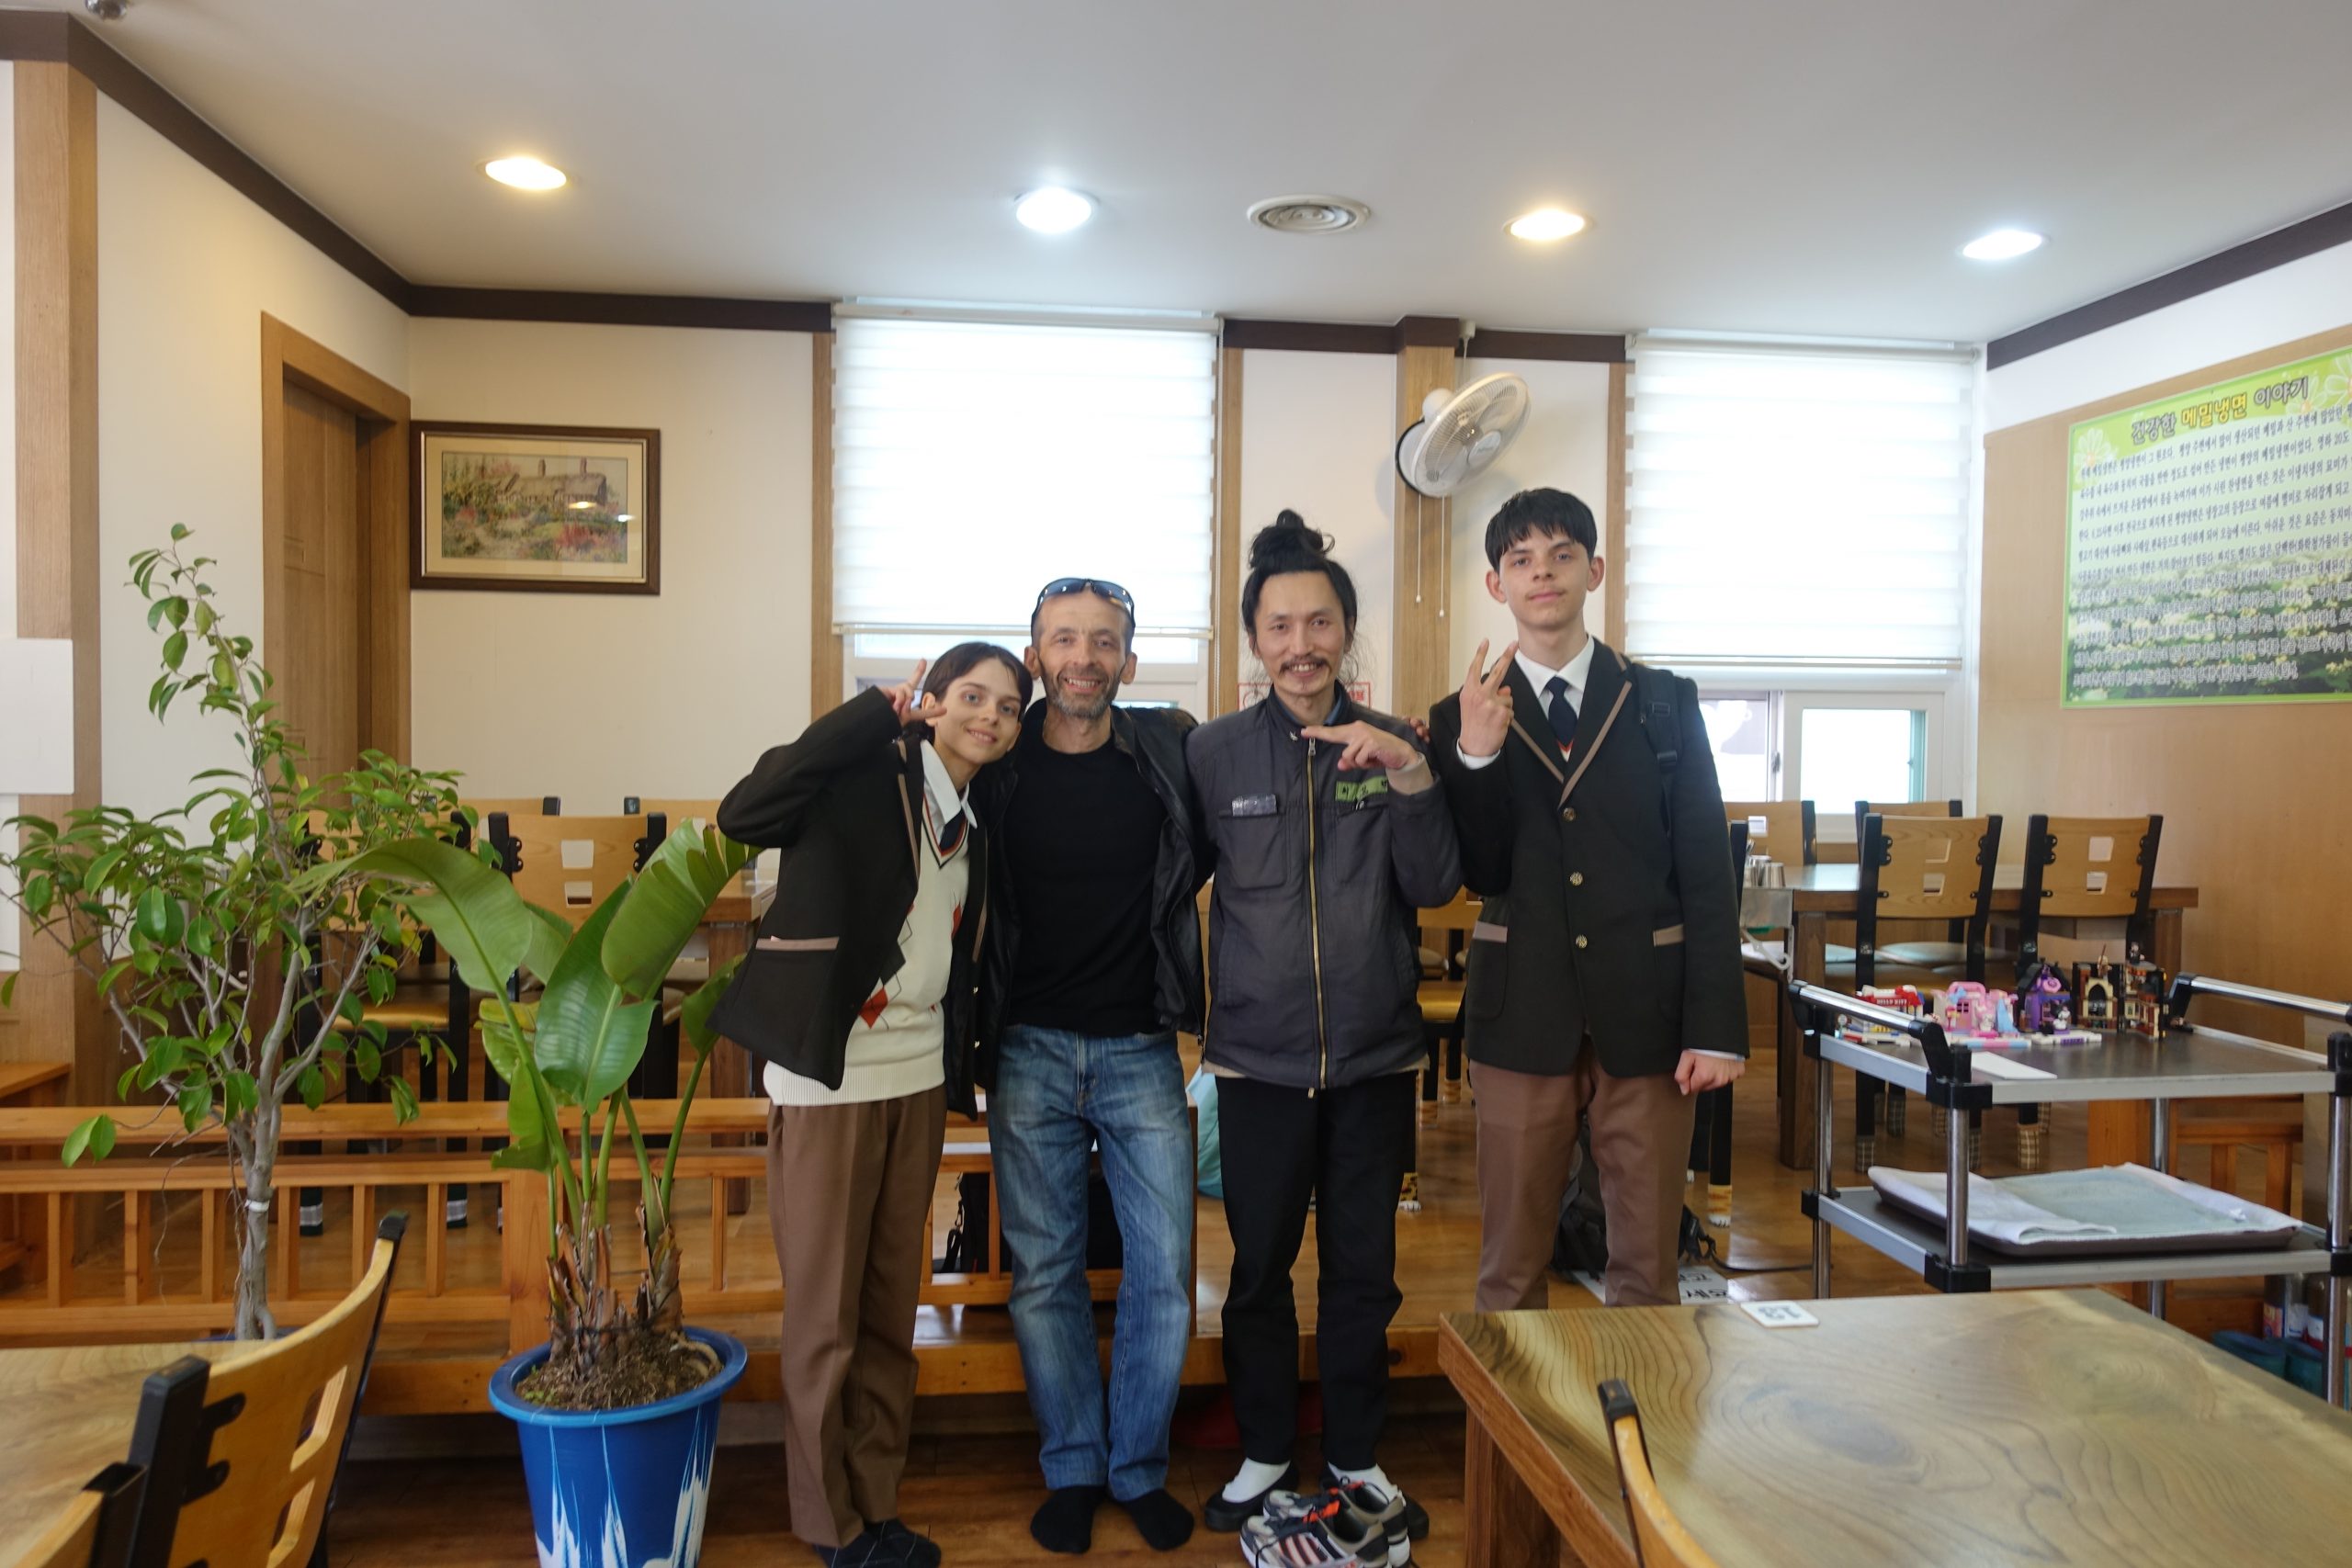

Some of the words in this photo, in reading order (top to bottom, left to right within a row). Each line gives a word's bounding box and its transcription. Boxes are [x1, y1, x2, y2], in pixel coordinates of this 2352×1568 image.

[2132, 413, 2177, 445] 건강한
[2181, 393, 2247, 428] 메밀냉면
[2254, 376, 2309, 409] 이야기
[2148, 451, 2154, 464] 그
[2179, 442, 2190, 457] 평양
[2192, 436, 2216, 454] 주변에서
[2219, 433, 2231, 447] 많이
[2234, 425, 2259, 444] 생산되던
[2263, 420, 2283, 437] 메밀과
[2286, 418, 2292, 432] 산
[2296, 412, 2316, 430] 주변에
[2320, 406, 2342, 424] 많았던
[2171, 466, 2187, 480] 정도로
[2204, 459, 2216, 474] 만든
[2219, 455, 2237, 470] 냉면이
[2240, 450, 2258, 467] 평양의
[2317, 434, 2331, 450] 영하
[2335, 429, 2348, 446] 20도
[2199, 483, 2211, 498] 이가
[2214, 480, 2225, 495] 시린
[2256, 471, 2268, 487] 먹은
[2272, 468, 2284, 484] 것은
[2288, 460, 2323, 480] 이냉치냉의
[2326, 455, 2347, 473] 묘미가
[2206, 502, 2230, 519] 냉장고의
[2233, 498, 2256, 514] 등장으로
[2260, 493, 2278, 510] 여름에
[2282, 490, 2301, 506] 별미로
[2304, 483, 2332, 502] 자리잡게
[2335, 480, 2348, 496] 되고
[2181, 530, 2204, 546] 대신하게
[2206, 528, 2217, 542] 되어
[2221, 525, 2238, 540] 오늘에
[2264, 516, 2284, 533] 아쉬운
[2289, 513, 2301, 529] 것은
[2304, 510, 2325, 527] 요즘은
[2259, 543, 2271, 557] 않은
